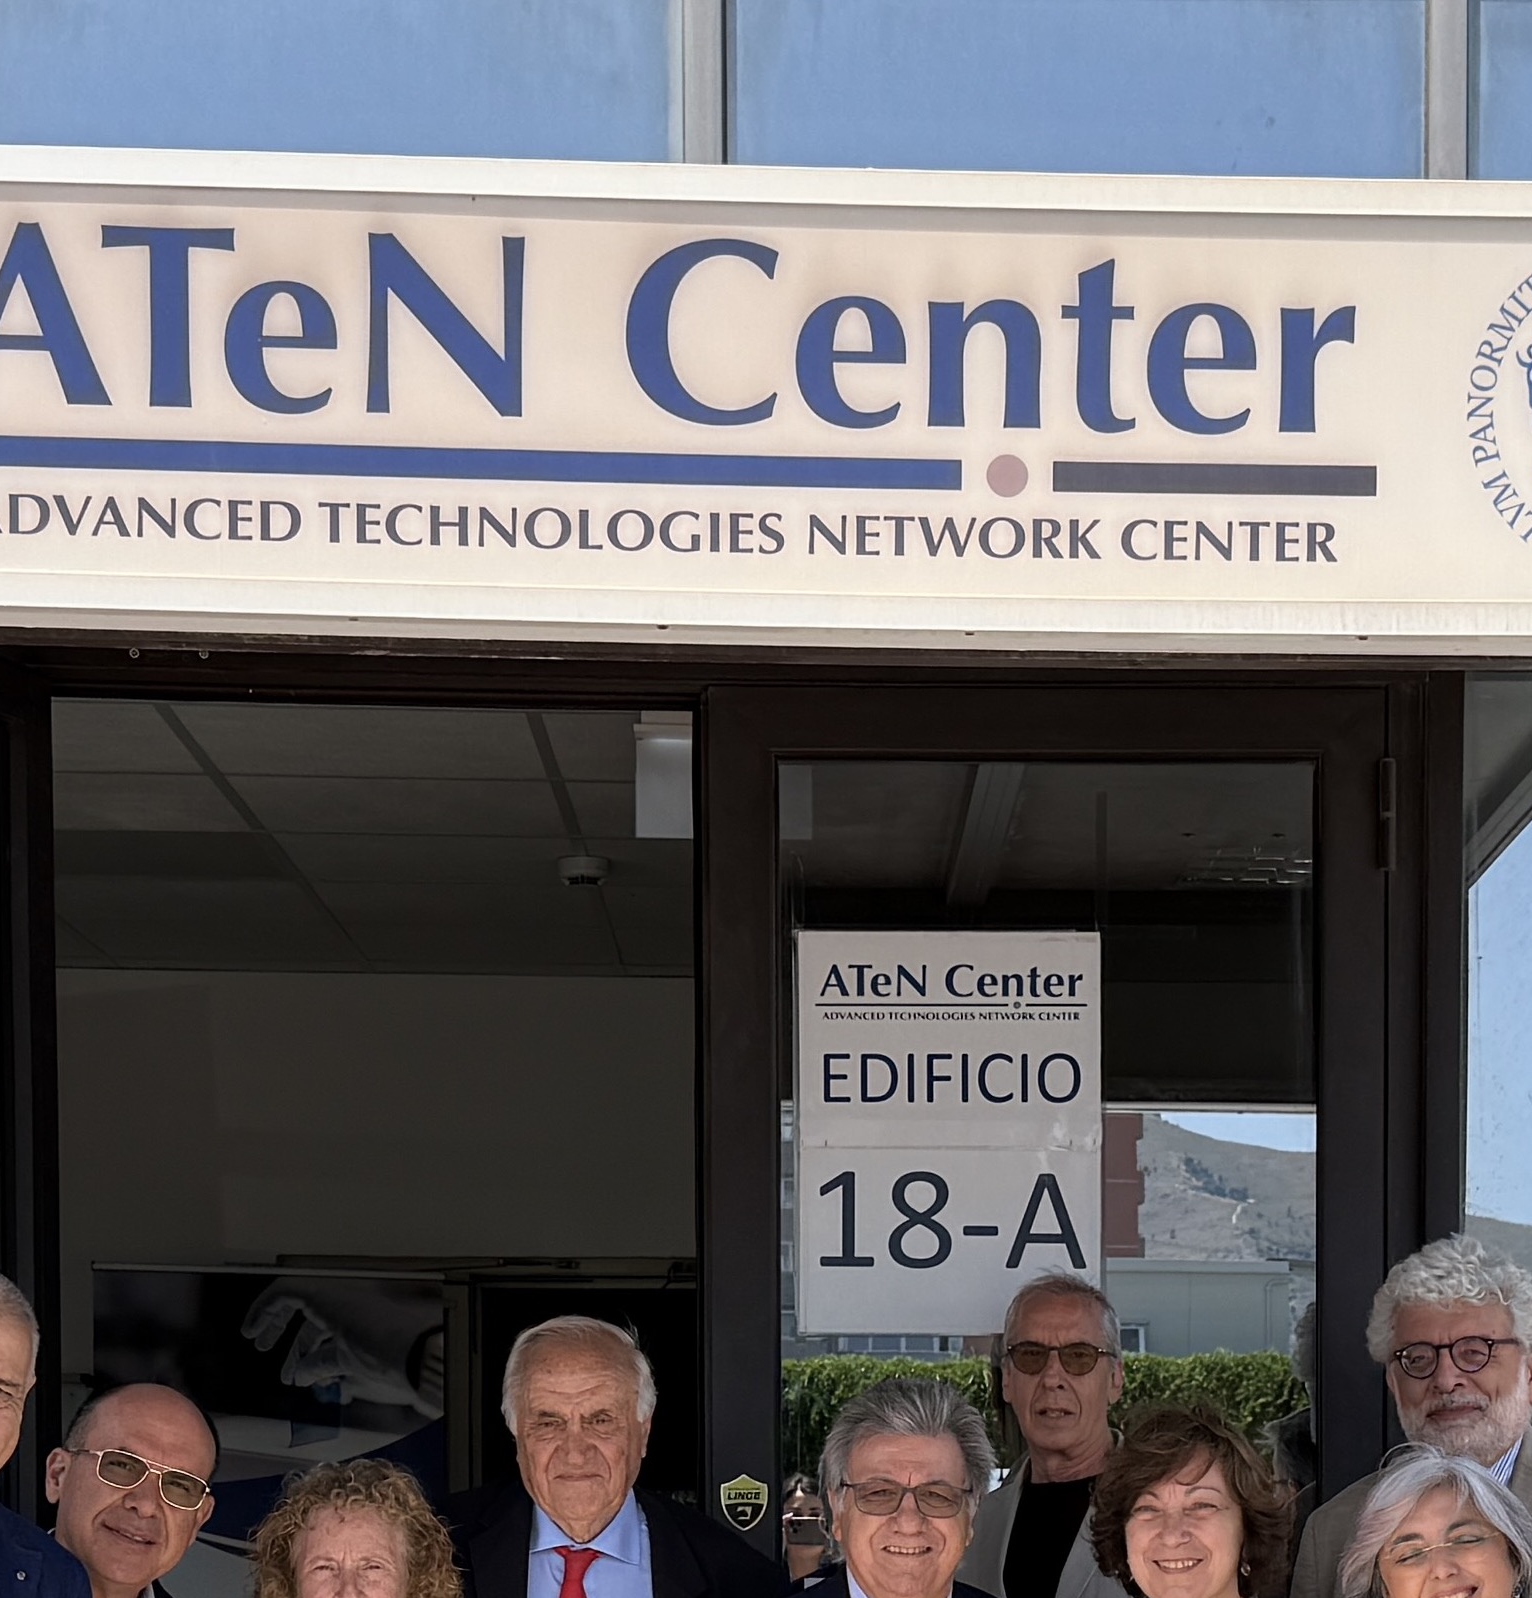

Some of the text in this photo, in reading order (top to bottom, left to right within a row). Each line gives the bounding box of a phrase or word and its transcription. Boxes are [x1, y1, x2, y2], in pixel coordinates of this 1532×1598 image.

[625, 238, 1357, 435] Center
[318, 502, 785, 554] TECHNOLOGIES
[809, 515, 1102, 559] NETWORK
[1122, 520, 1338, 562] CENTER
[820, 964, 1084, 998] ATeN Center
[822, 1011, 1081, 1021] ADVANCED TECHNOLOGIES NETWORK CENTER
[823, 1053, 1082, 1103] EDIFICIO
[820, 1171, 1087, 1269] 18-A
[727, 1491, 761, 1500] LINCE
